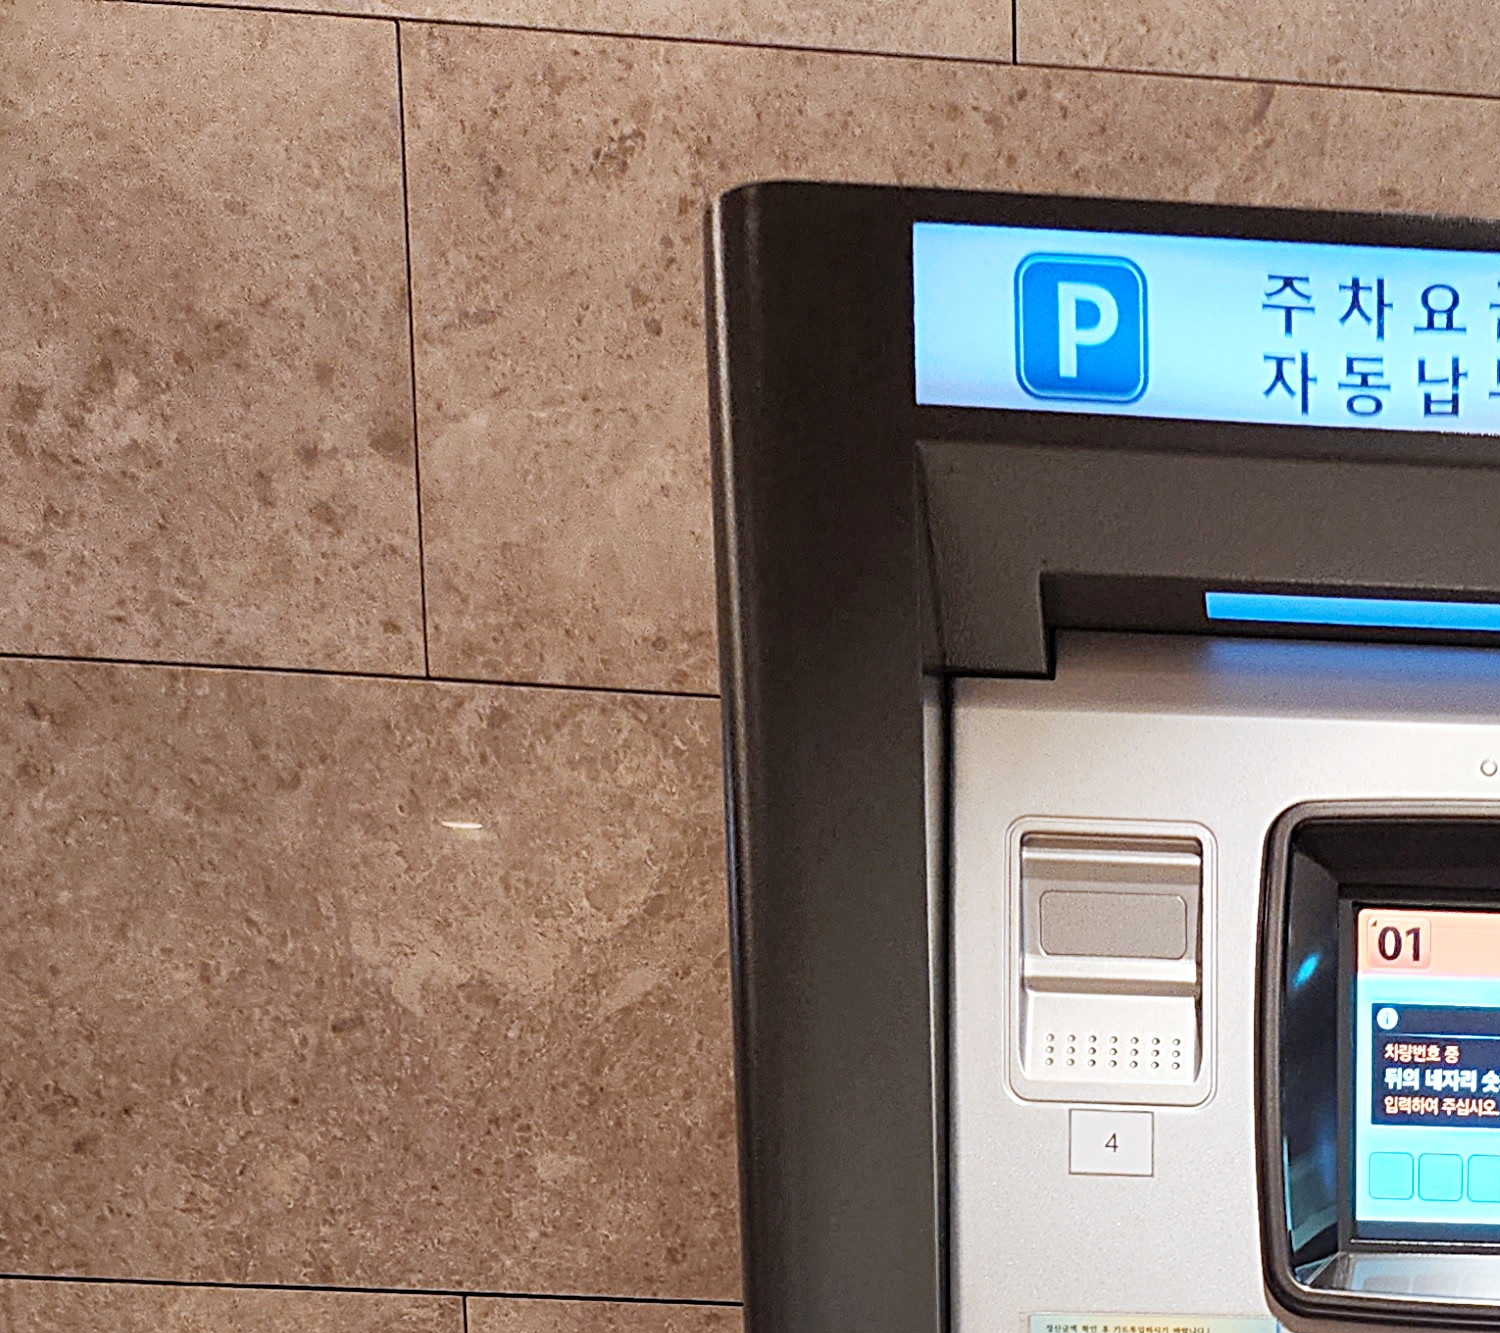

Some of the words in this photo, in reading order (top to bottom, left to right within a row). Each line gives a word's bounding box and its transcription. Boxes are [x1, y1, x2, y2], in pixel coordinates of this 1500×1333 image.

[1057, 281, 1118, 378] P
[1378, 926, 1422, 962] 01
[1384, 1043, 1440, 1062] 차량번호
[1444, 1045, 1460, 1064] 중
[1384, 1067, 1419, 1090] 뒤의
[1425, 1069, 1477, 1092] 네자리
[1384, 1096, 1439, 1115] 입력하여
[1104, 1133, 1119, 1153] 4
